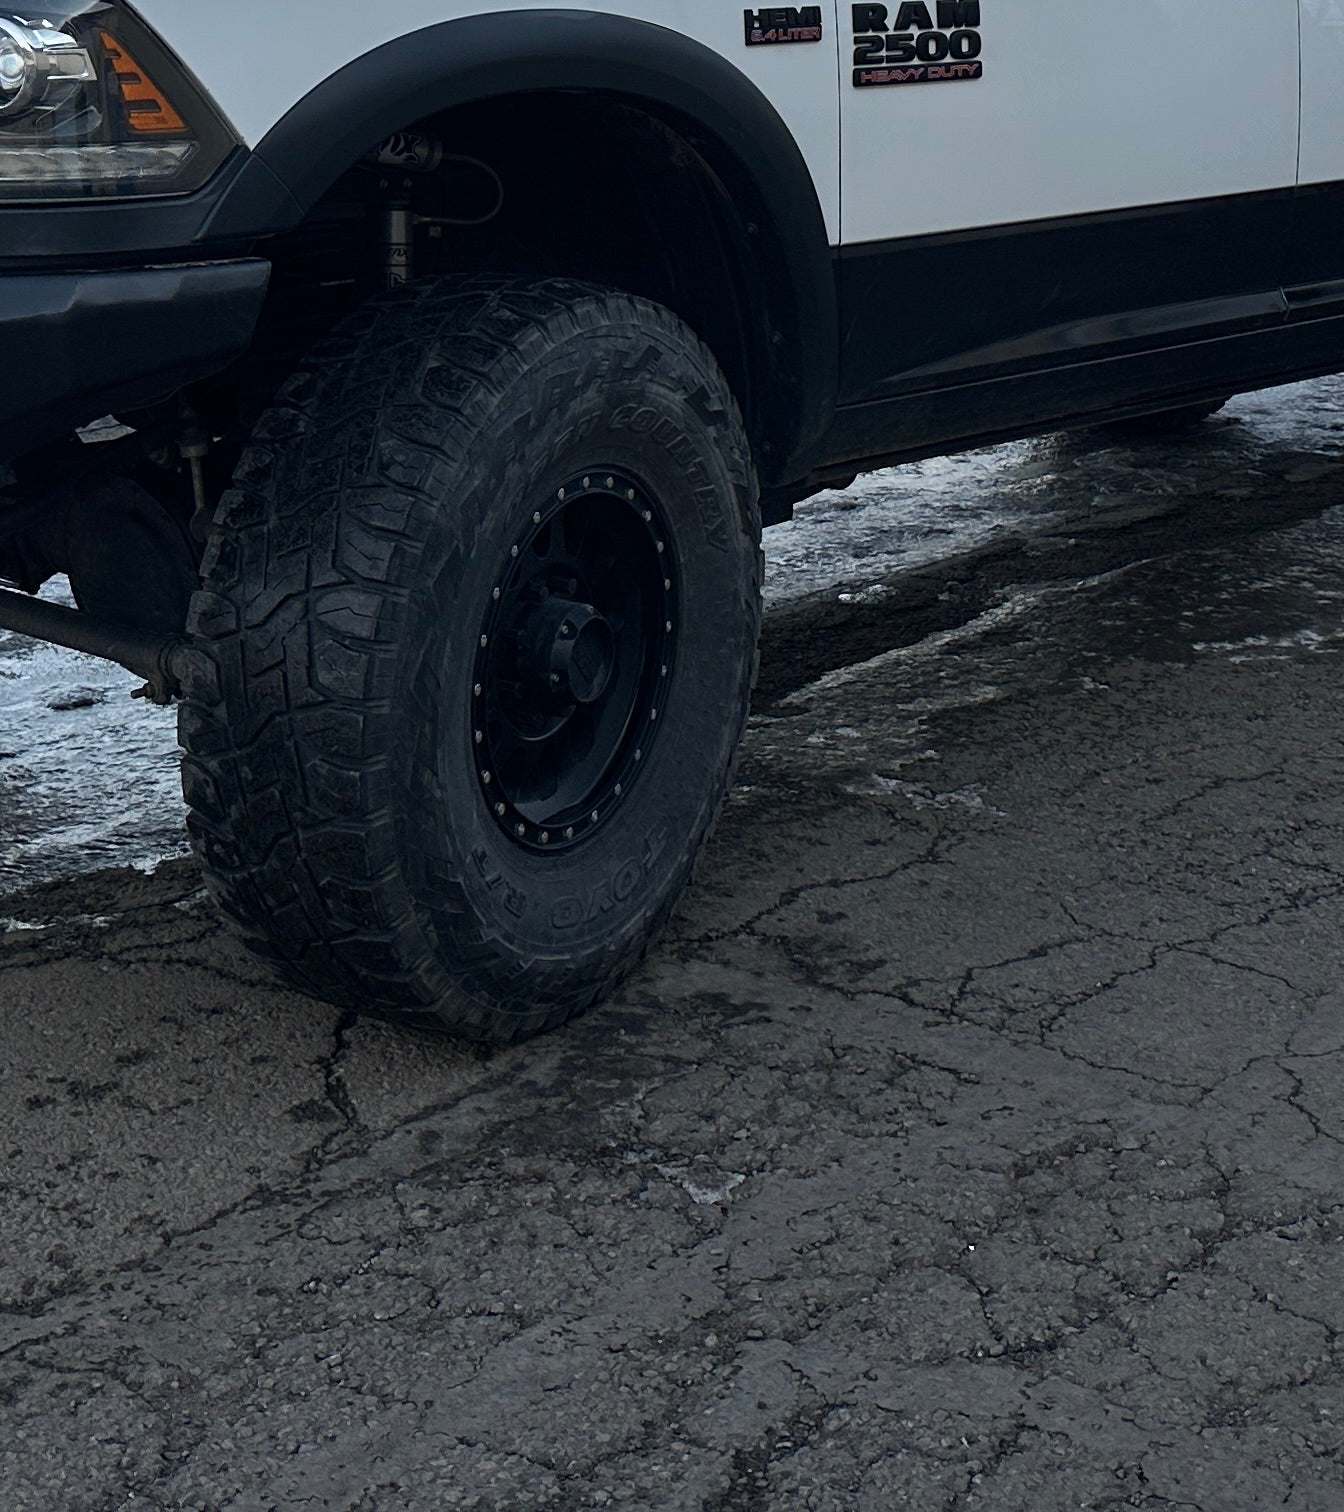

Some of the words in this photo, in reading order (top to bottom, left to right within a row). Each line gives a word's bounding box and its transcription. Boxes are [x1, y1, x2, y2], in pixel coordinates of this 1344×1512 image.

[744, 5, 822, 28] HEMI
[778, 26, 821, 41] LITER
[853, 29, 982, 66] 2500
[860, 66, 925, 84] HEAVY
[927, 62, 980, 80] DUTY
[608, 402, 729, 554] COUNTRY
[550, 824, 668, 929] TOYO
